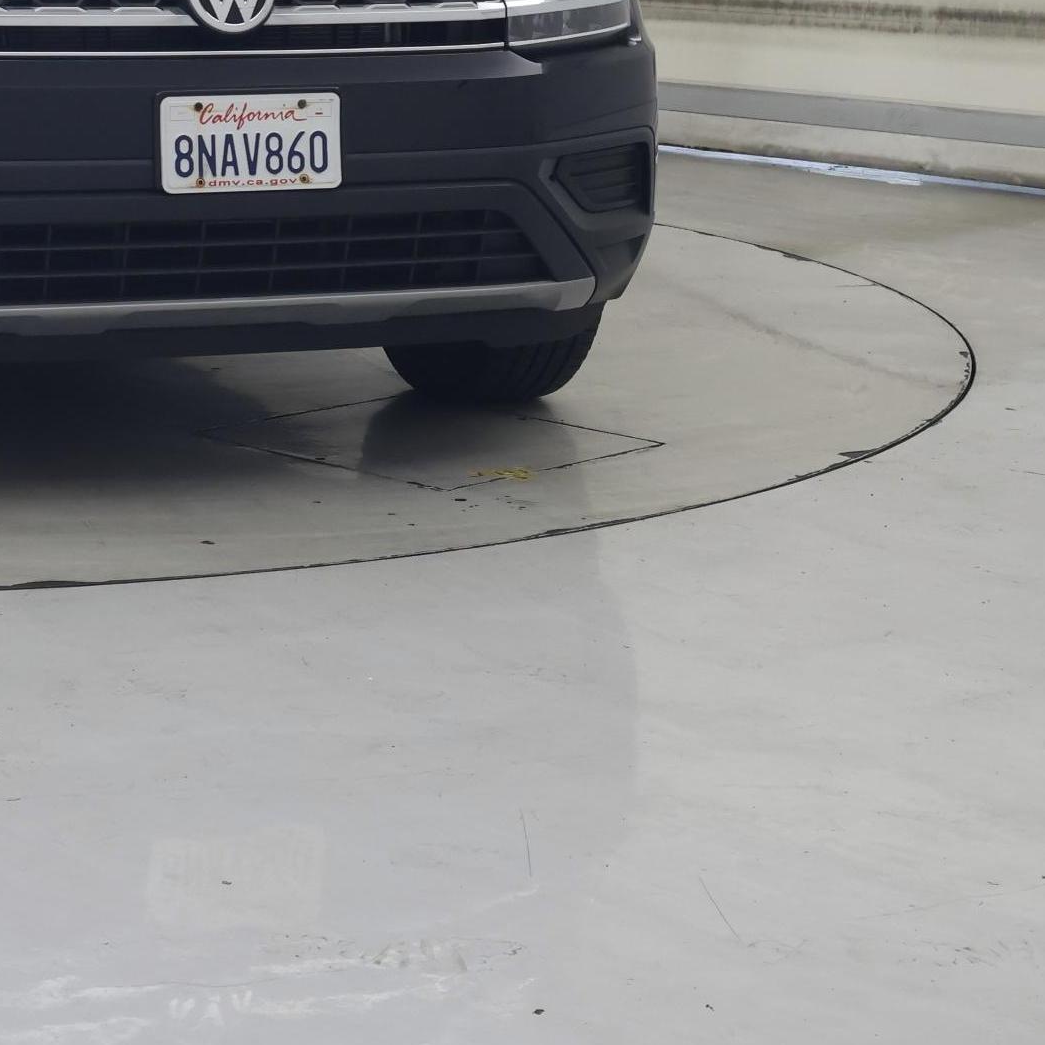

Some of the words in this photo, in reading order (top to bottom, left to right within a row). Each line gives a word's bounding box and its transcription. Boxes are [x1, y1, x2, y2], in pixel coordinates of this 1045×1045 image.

[199, 102, 307, 130] California
[174, 130, 328, 178] 8NAV860
[208, 177, 297, 187] dmv.ca.gov
